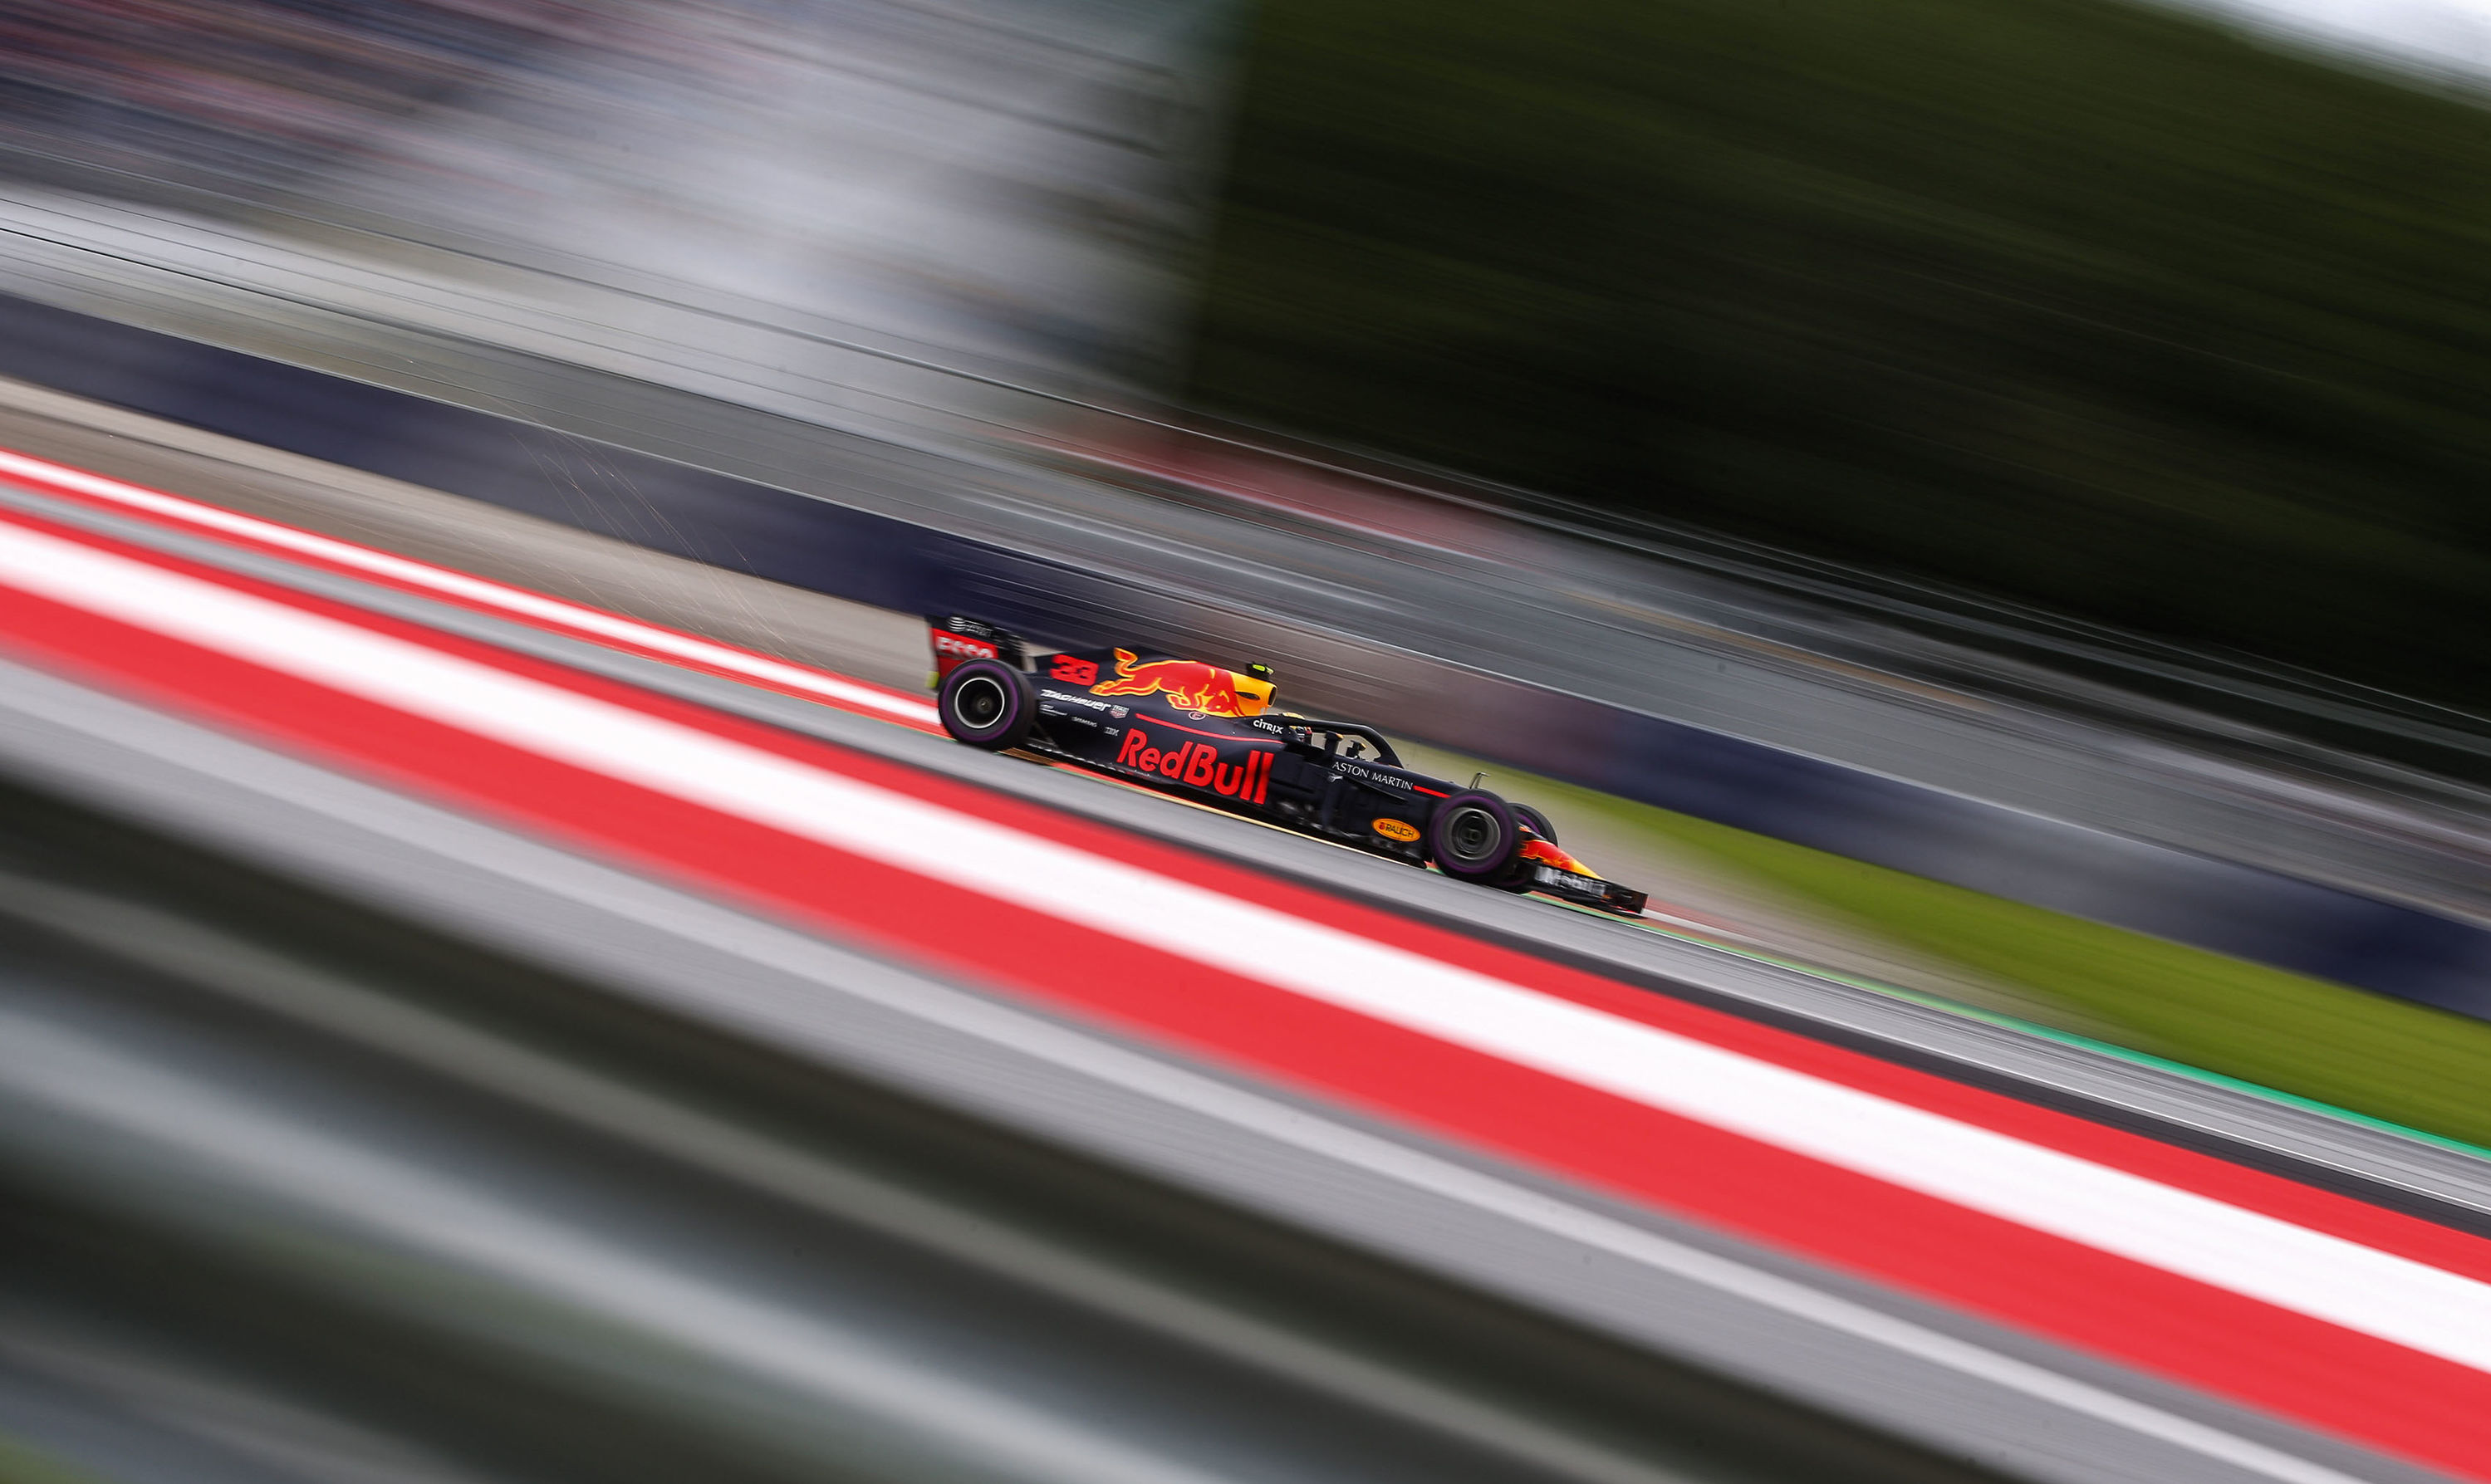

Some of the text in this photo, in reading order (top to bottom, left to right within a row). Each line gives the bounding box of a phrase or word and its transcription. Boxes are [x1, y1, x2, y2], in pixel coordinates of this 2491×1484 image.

[1050, 654, 1099, 686] 33
[1332, 762, 1414, 791] ASTON MARTIN
[1385, 823, 1415, 838] RAUCH
